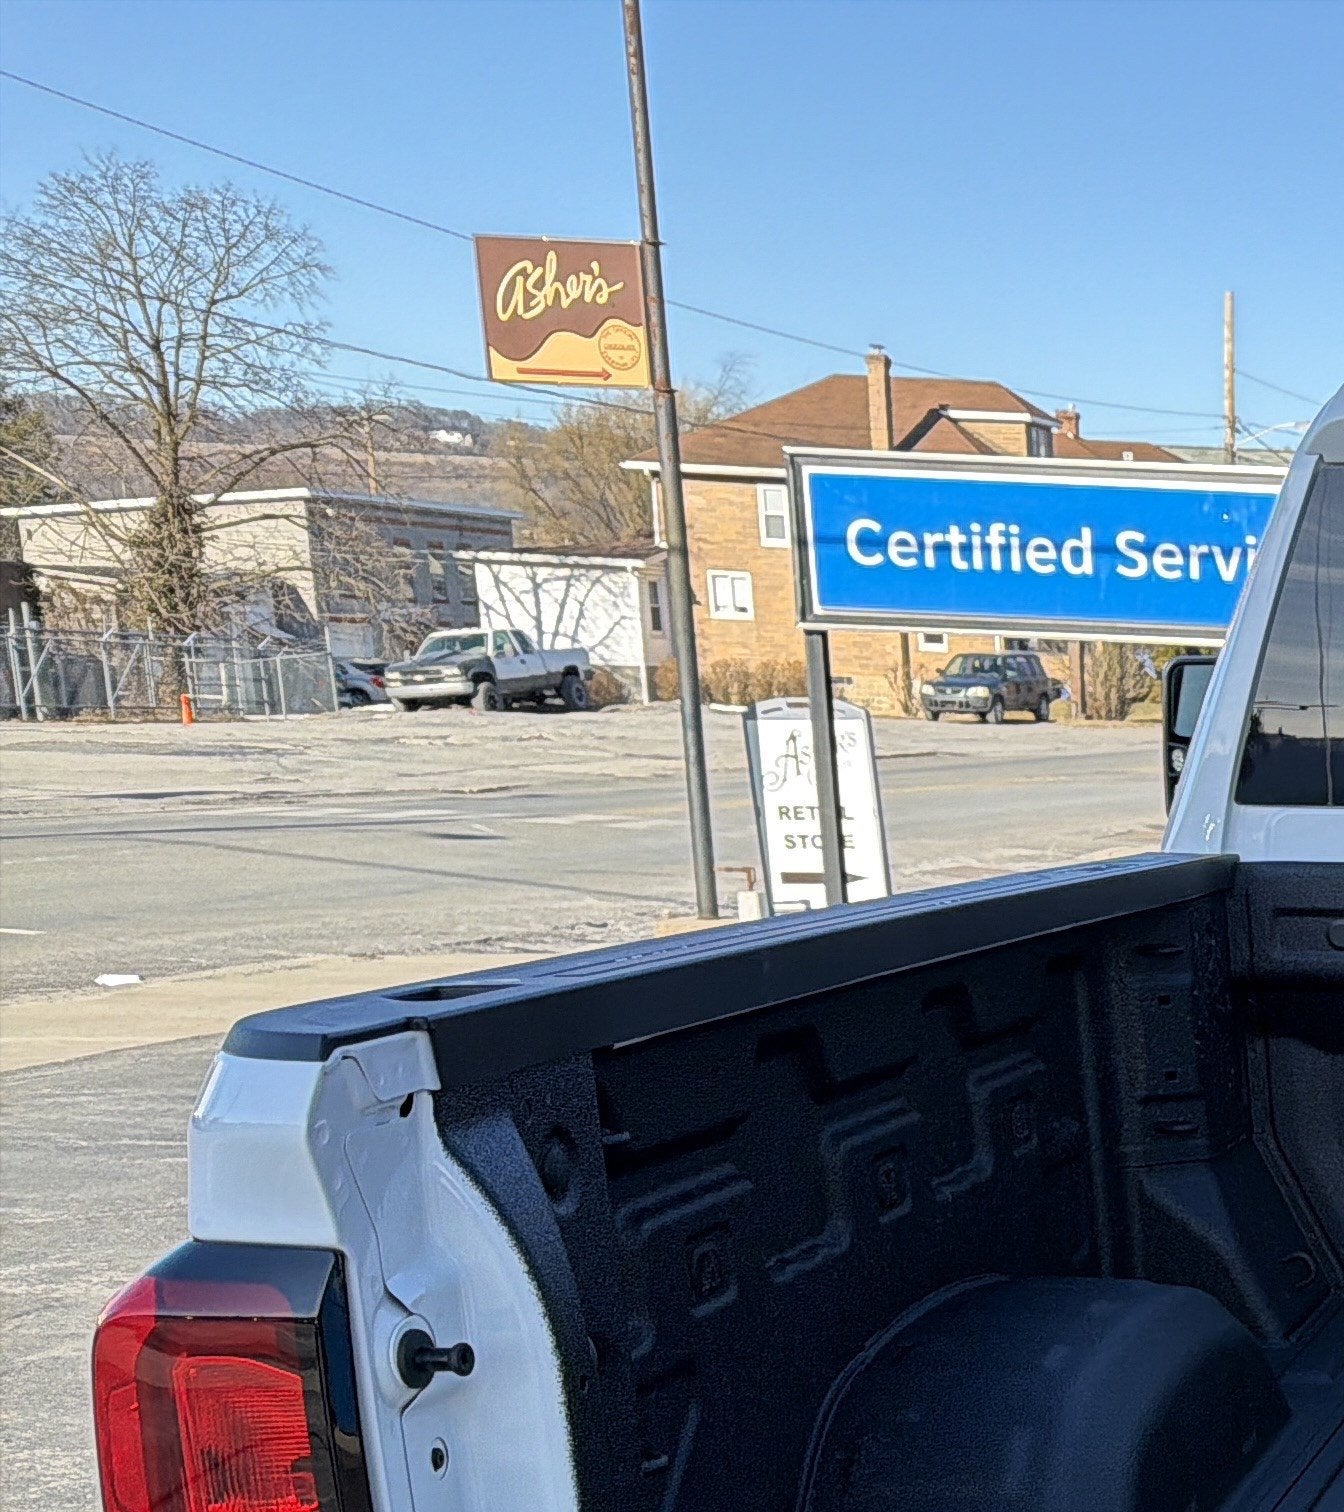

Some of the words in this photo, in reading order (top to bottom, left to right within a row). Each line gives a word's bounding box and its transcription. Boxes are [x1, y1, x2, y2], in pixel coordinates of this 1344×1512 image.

[496, 250, 625, 322] Asher's
[845, 518, 1095, 576] Certified
[778, 806, 855, 820] RETL
[784, 834, 856, 849] STOE
